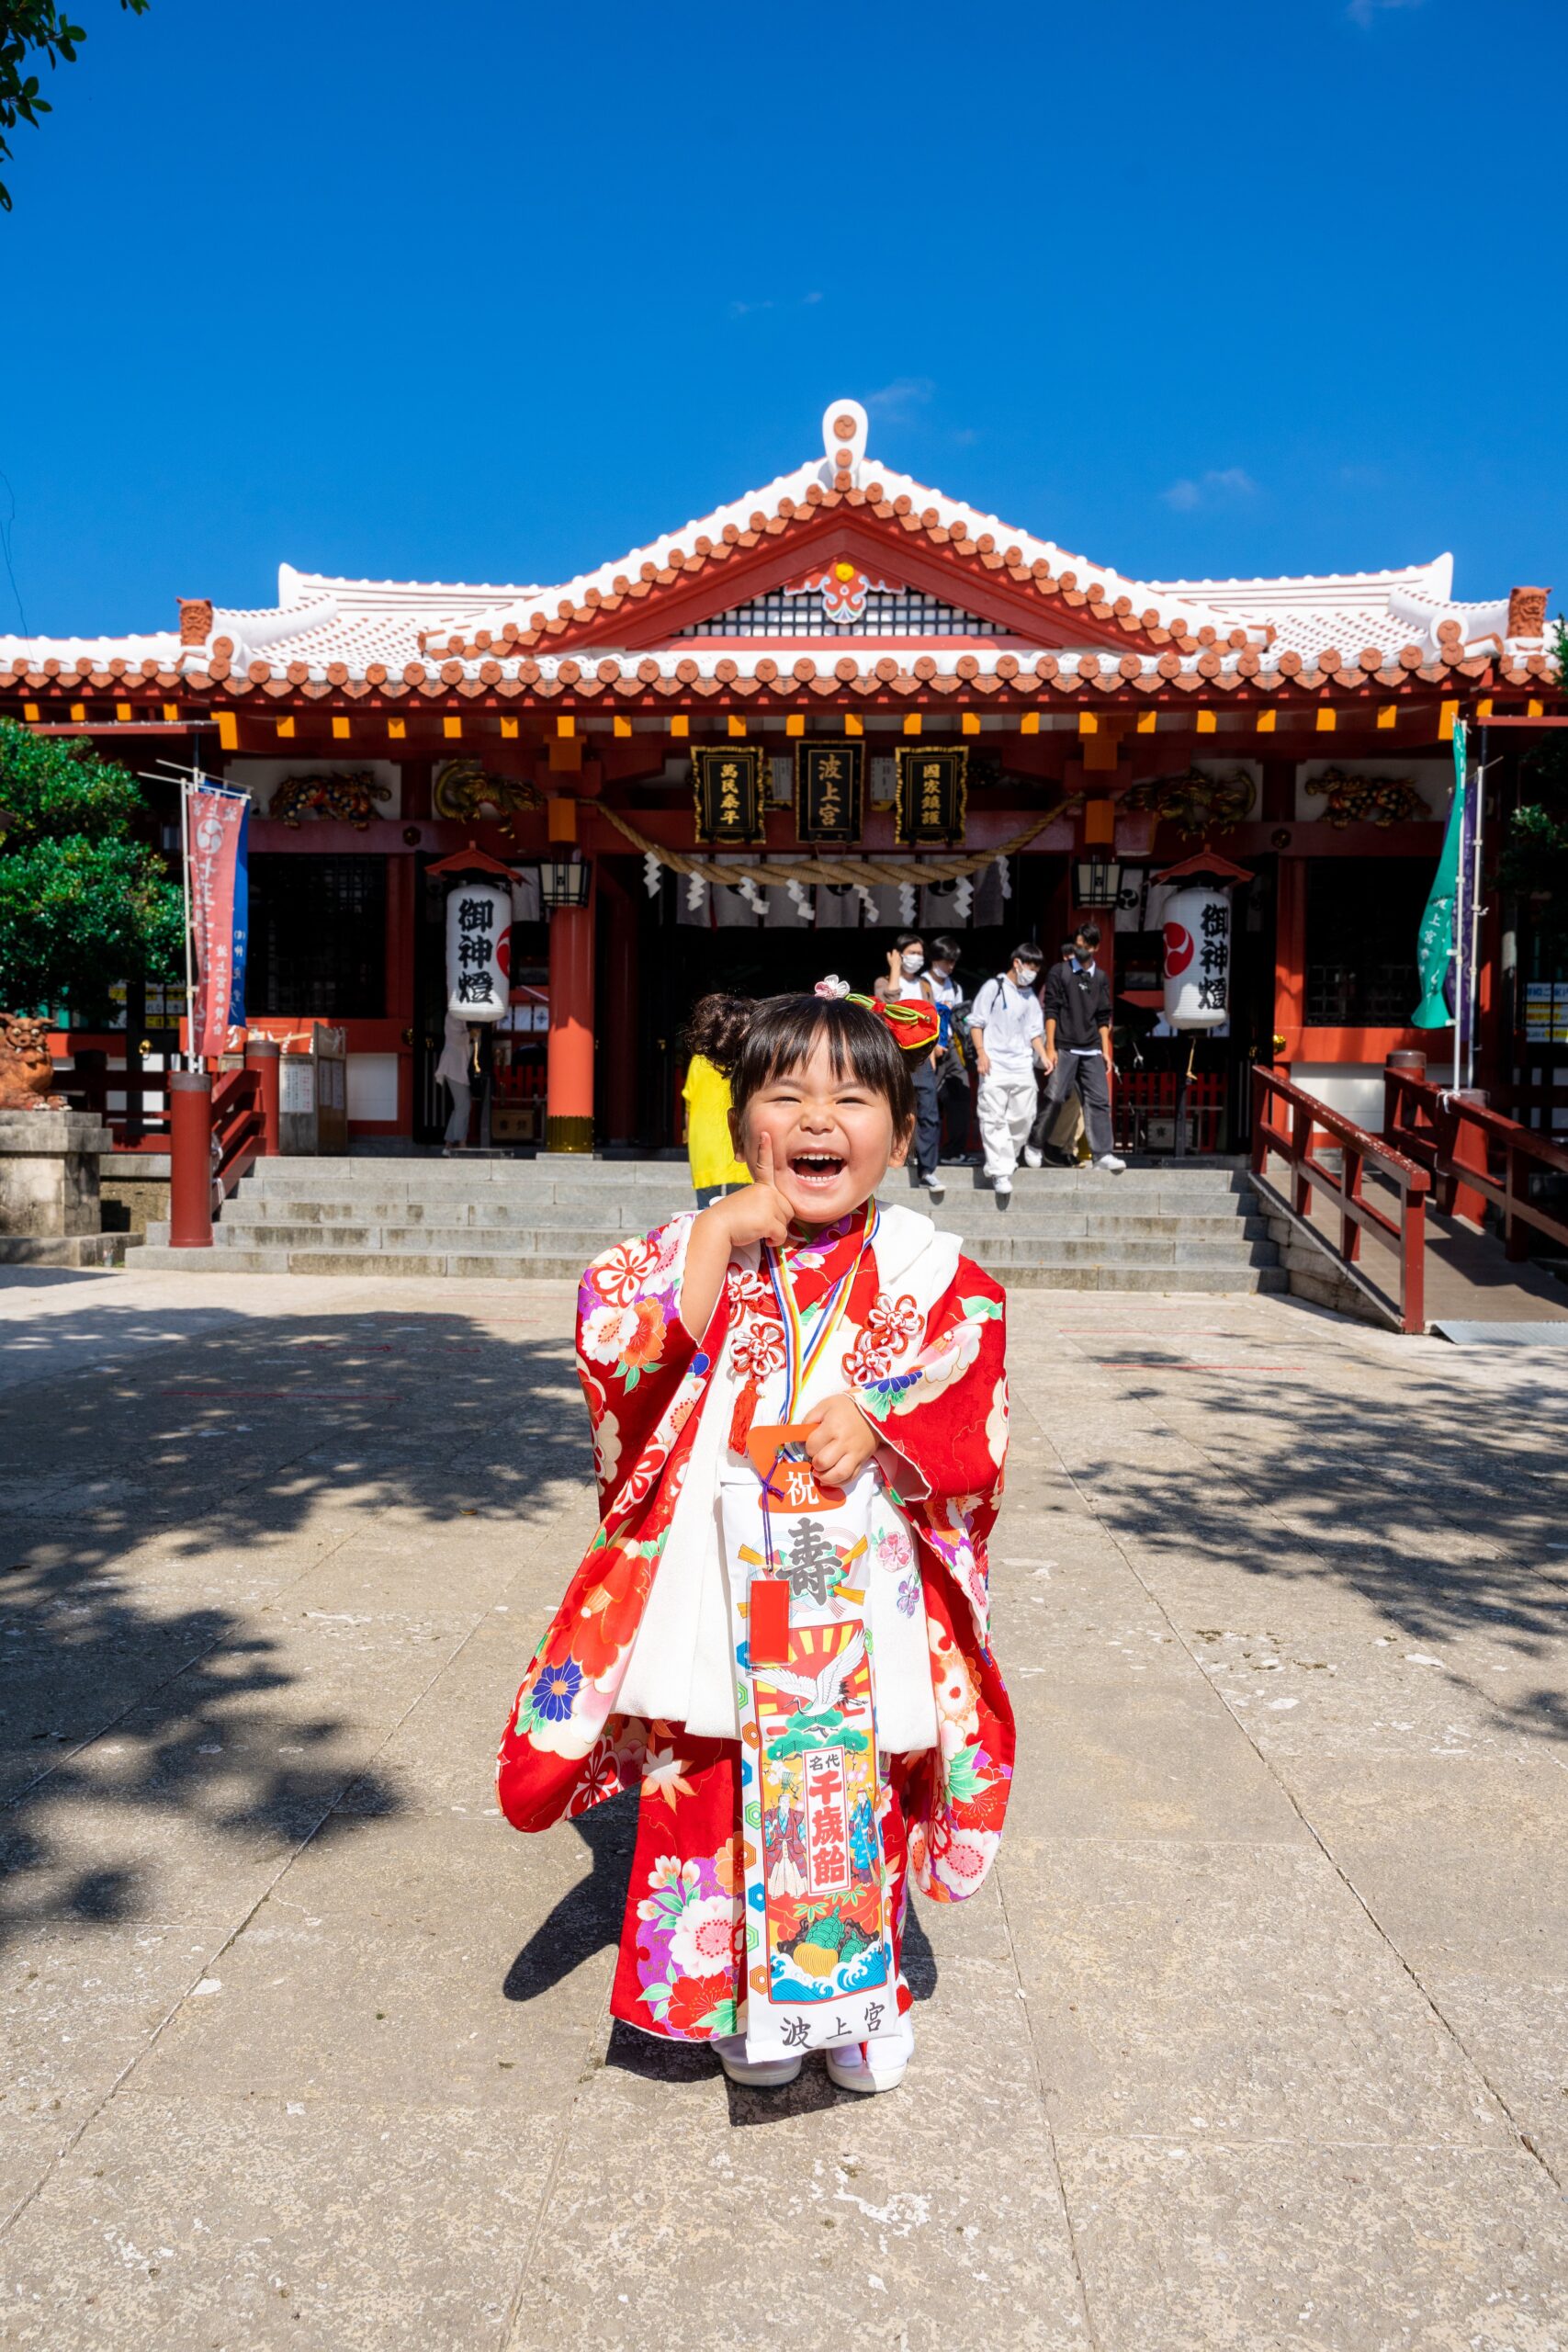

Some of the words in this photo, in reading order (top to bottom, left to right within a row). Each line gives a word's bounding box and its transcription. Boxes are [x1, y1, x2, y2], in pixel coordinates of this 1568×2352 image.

[818, 753, 843, 826] 波上宮
[458, 898, 494, 1004] 御神燈
[1198, 903, 1229, 1011] 御神燈
[785, 1471, 819, 1506] 祝
[809, 1753, 840, 1770] 名代
[808, 1770, 845, 1886] 千歳飴
[780, 2002, 885, 2049] 波上宮
